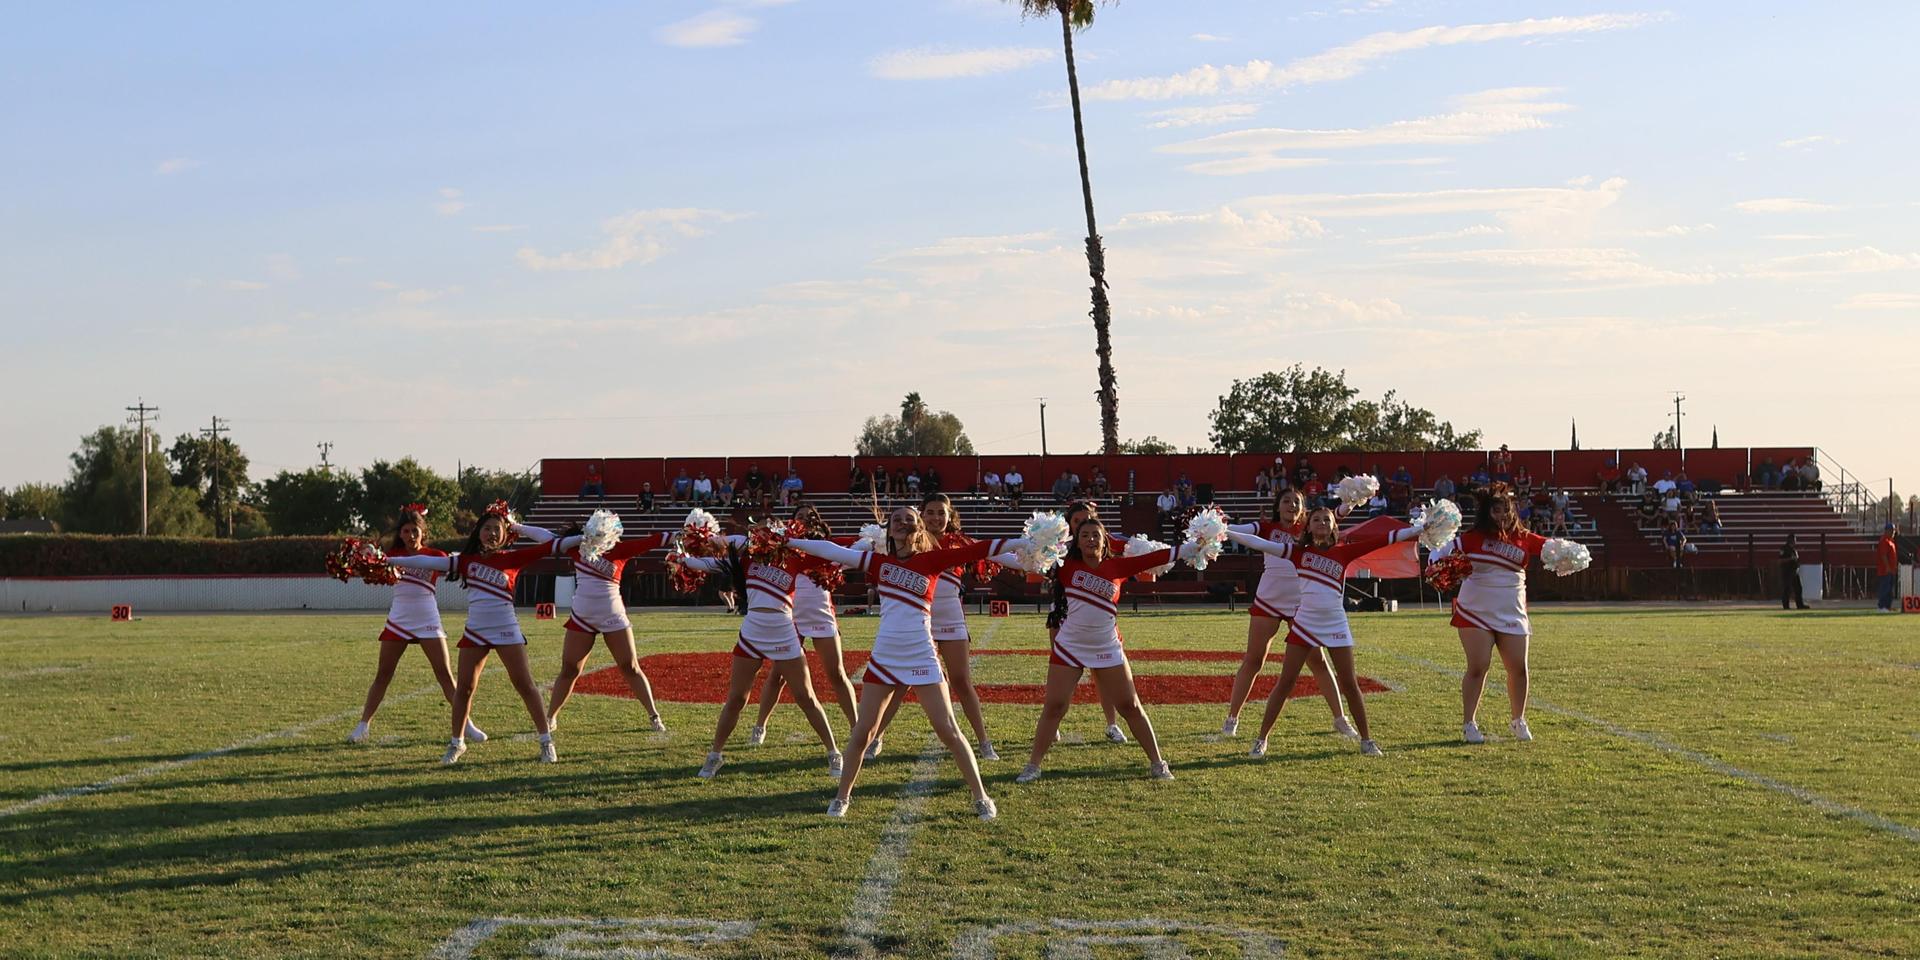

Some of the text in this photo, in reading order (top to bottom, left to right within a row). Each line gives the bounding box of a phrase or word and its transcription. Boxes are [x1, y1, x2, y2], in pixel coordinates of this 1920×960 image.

[467, 562, 509, 586] CUHS
[747, 562, 793, 590] CUHS
[1301, 551, 1344, 578] CUHS
[879, 563, 930, 595] CUHS
[1071, 570, 1119, 600] CUHS
[112, 606, 128, 618] 30
[537, 604, 552, 616] 40
[992, 601, 1007, 614] 50
[1905, 596, 1920, 609] 30
